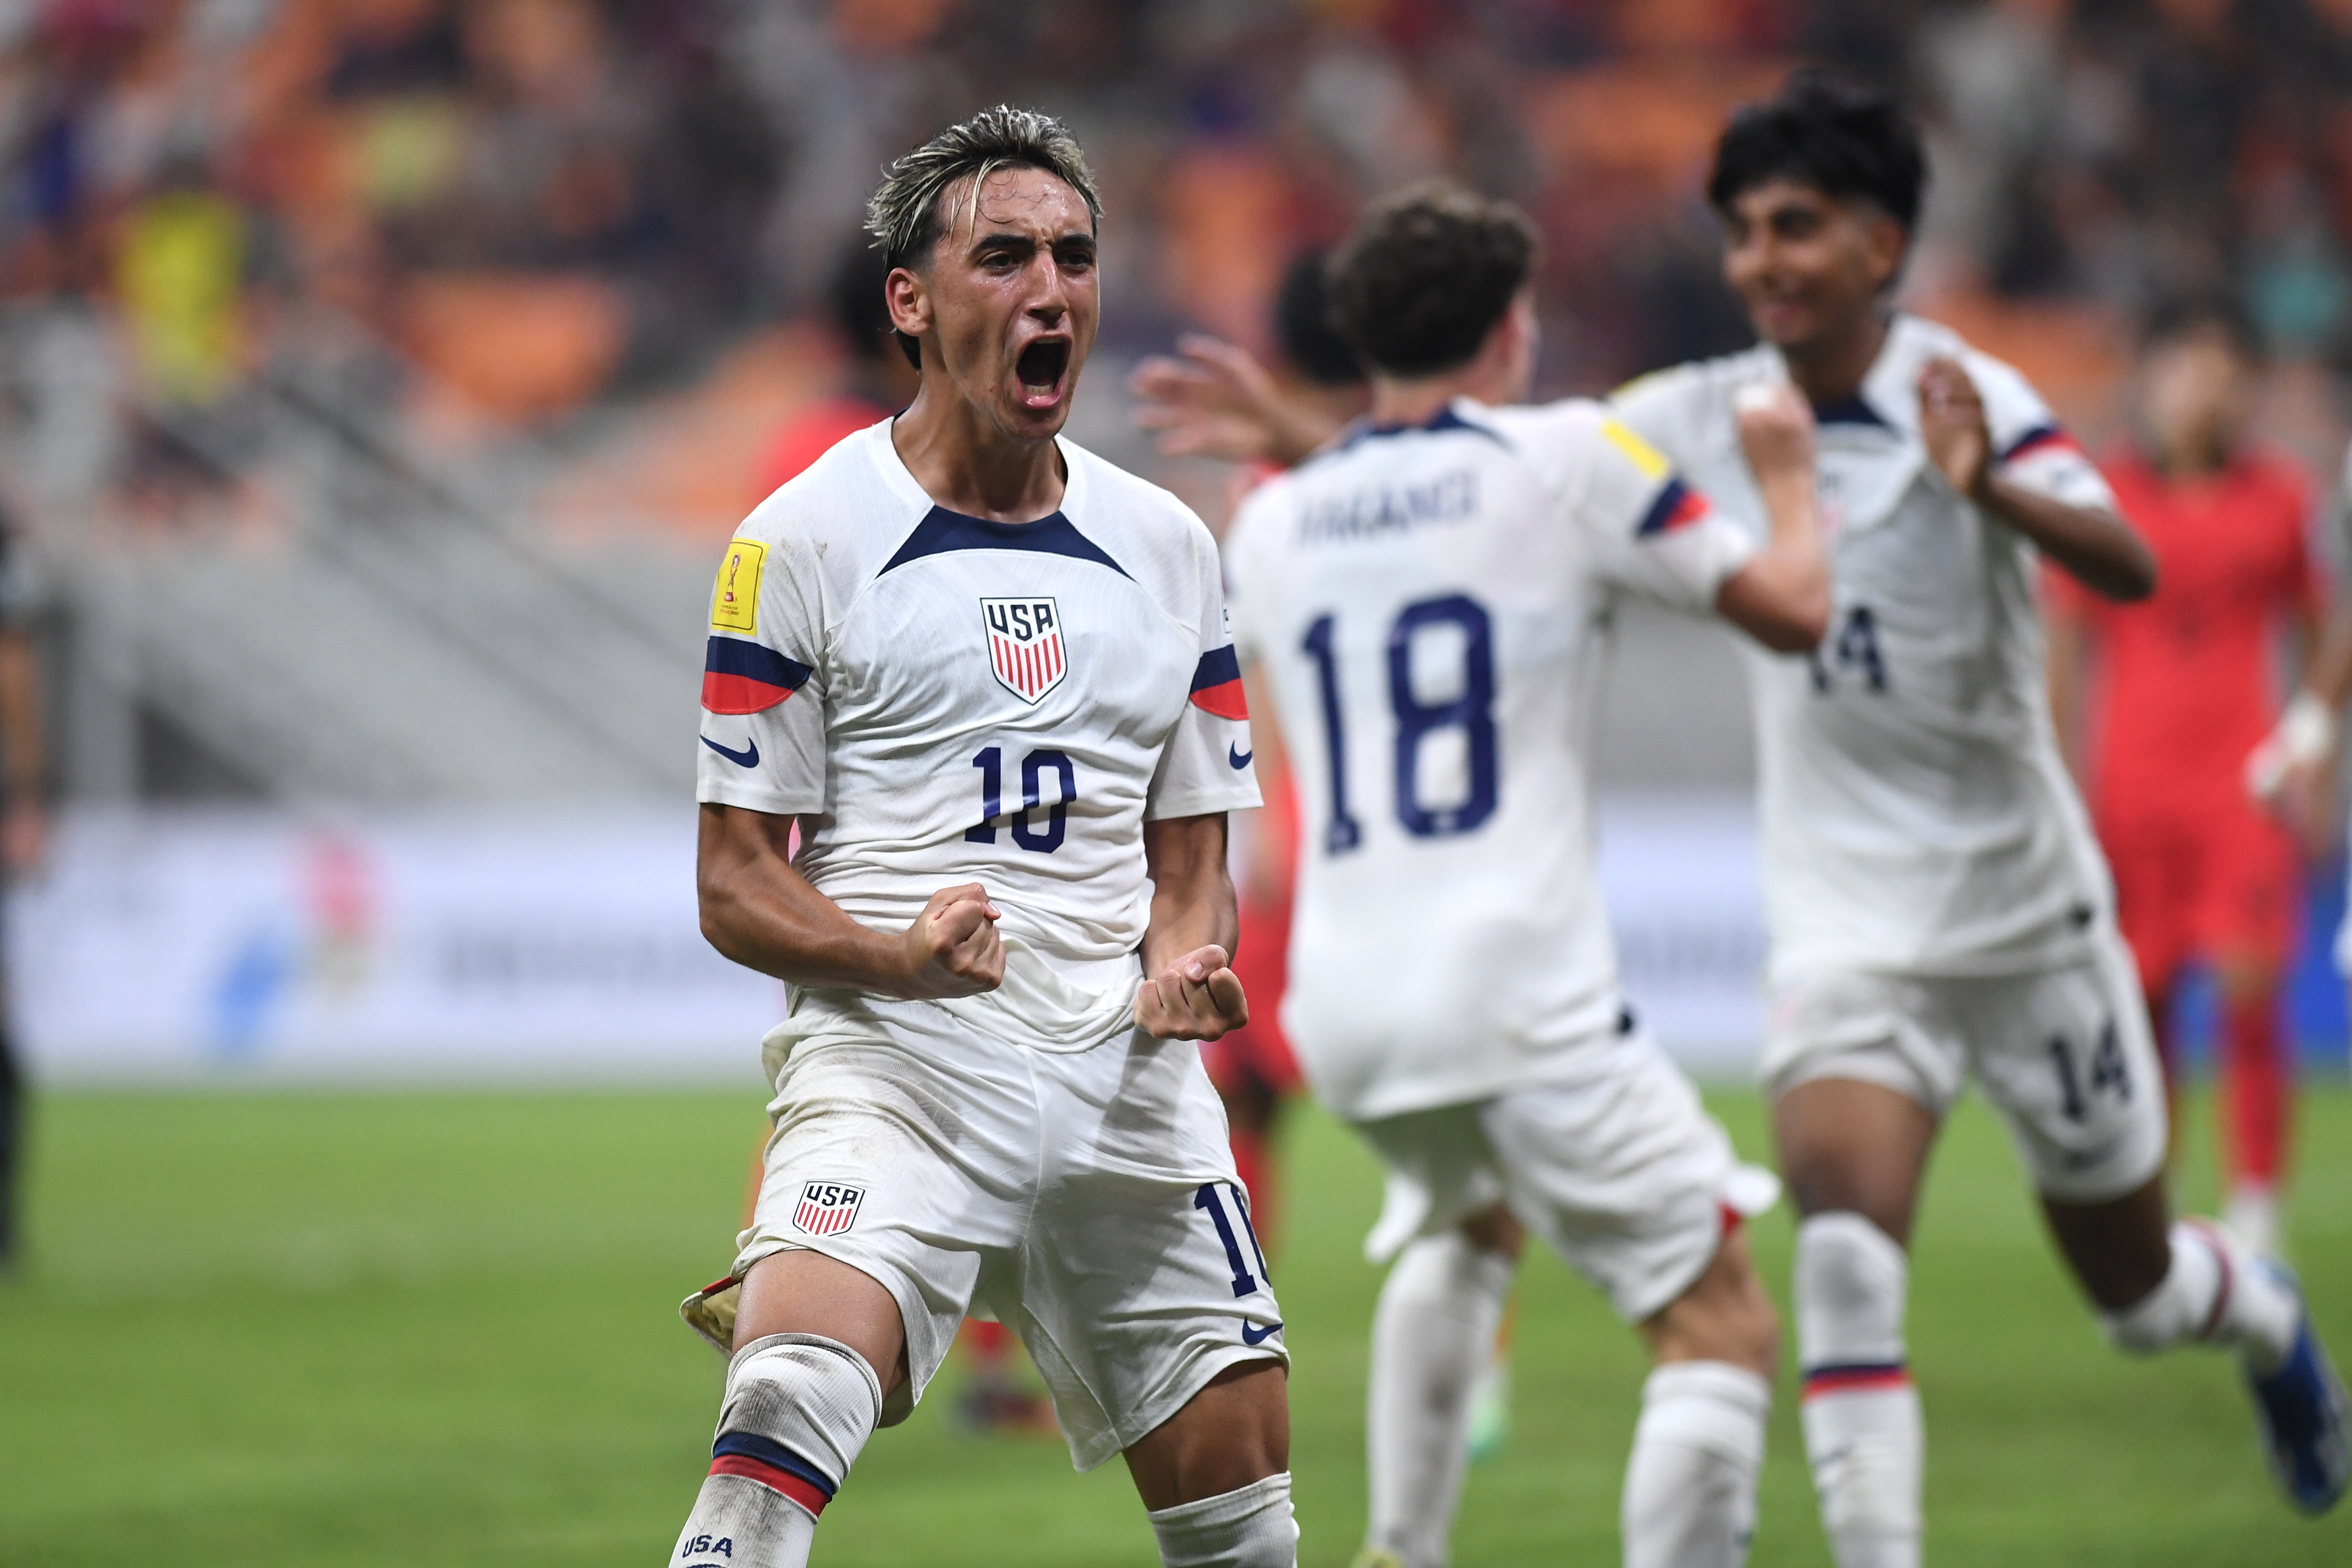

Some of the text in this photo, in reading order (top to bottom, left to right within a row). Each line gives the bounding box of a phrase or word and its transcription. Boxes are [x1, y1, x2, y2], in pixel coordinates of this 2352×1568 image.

[987, 604, 1053, 641] USA
[1301, 590, 1499, 855] 18
[965, 747, 1077, 854] 10
[2047, 1019, 2134, 1123] 14
[806, 1185, 859, 1207] USA
[682, 1534, 733, 1559] USA
